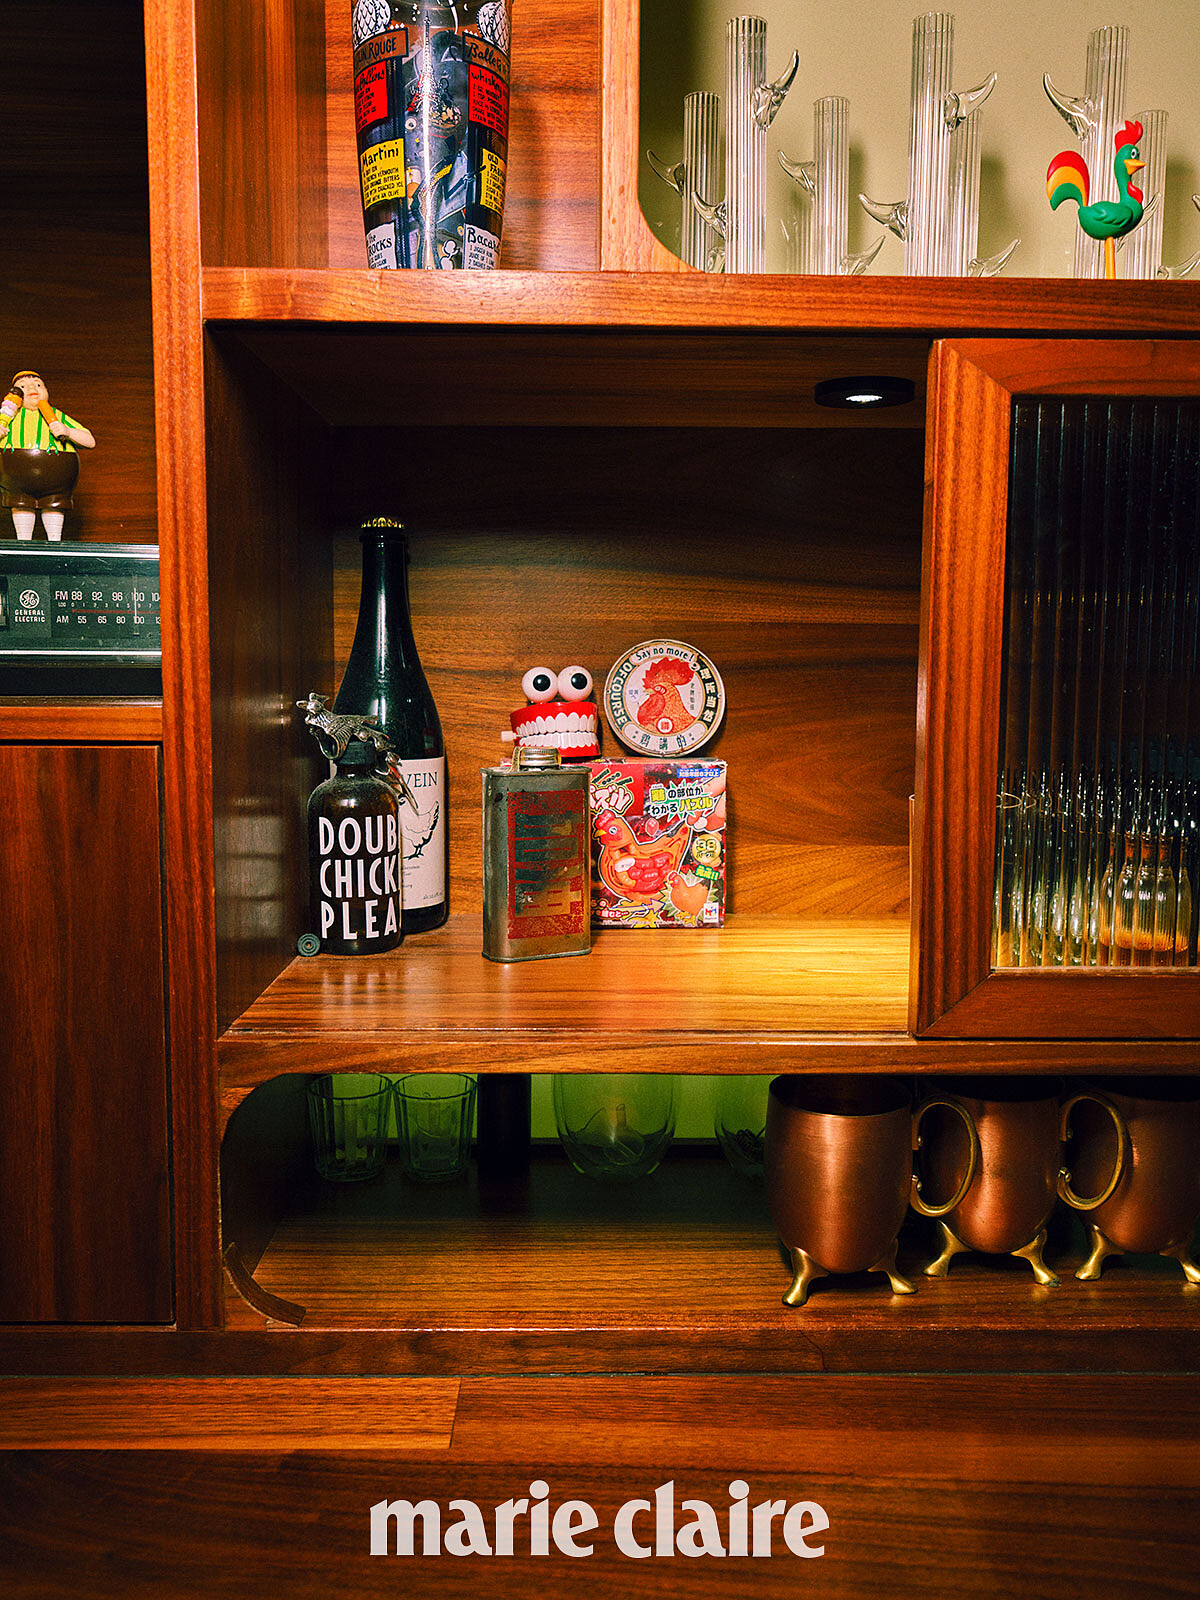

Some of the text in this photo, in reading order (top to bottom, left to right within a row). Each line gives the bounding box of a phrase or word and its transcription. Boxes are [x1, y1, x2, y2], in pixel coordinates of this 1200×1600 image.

[368, 37, 397, 60] ROUGE
[362, 142, 398, 168] Martini
[55, 591, 68, 600] FM
[71, 591, 82, 600] 88
[92, 592, 103, 600] 92
[112, 592, 123, 601] 96
[152, 593, 160, 602] 10
[78, 616, 87, 624] 55
[636, 648, 651, 661] Say
[318, 814, 396, 856] DOUB
[320, 855, 398, 898] CHICK
[321, 897, 398, 940] PLEA
